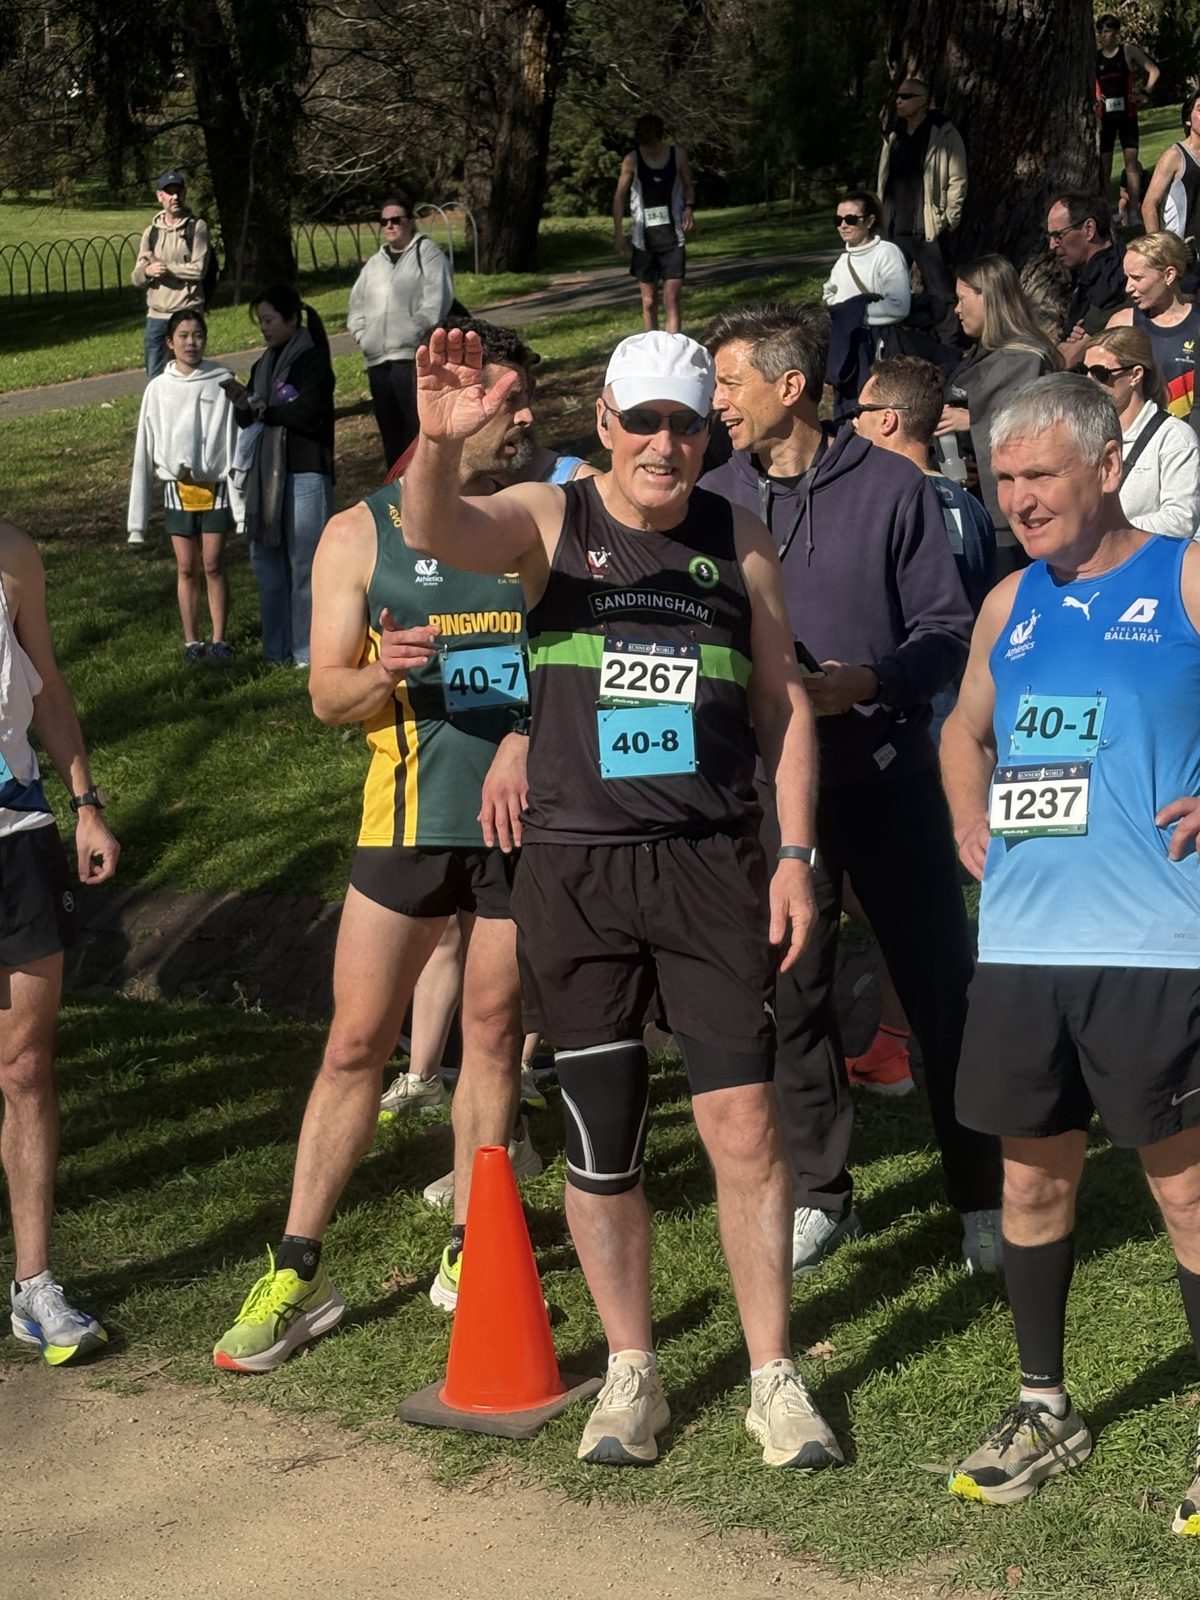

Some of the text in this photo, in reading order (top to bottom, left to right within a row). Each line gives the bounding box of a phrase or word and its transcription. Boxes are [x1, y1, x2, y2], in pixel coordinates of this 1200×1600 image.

[595, 593, 709, 620] SANDRINGHAM
[428, 611, 522, 636] RINGWOOD
[1104, 631, 1162, 643] BALLARAT
[449, 662, 520, 696] 40-7
[604, 659, 694, 694] 2267
[1015, 706, 1098, 740] 40-1
[612, 729, 679, 755] 40-8
[998, 786, 1083, 821] 1237
